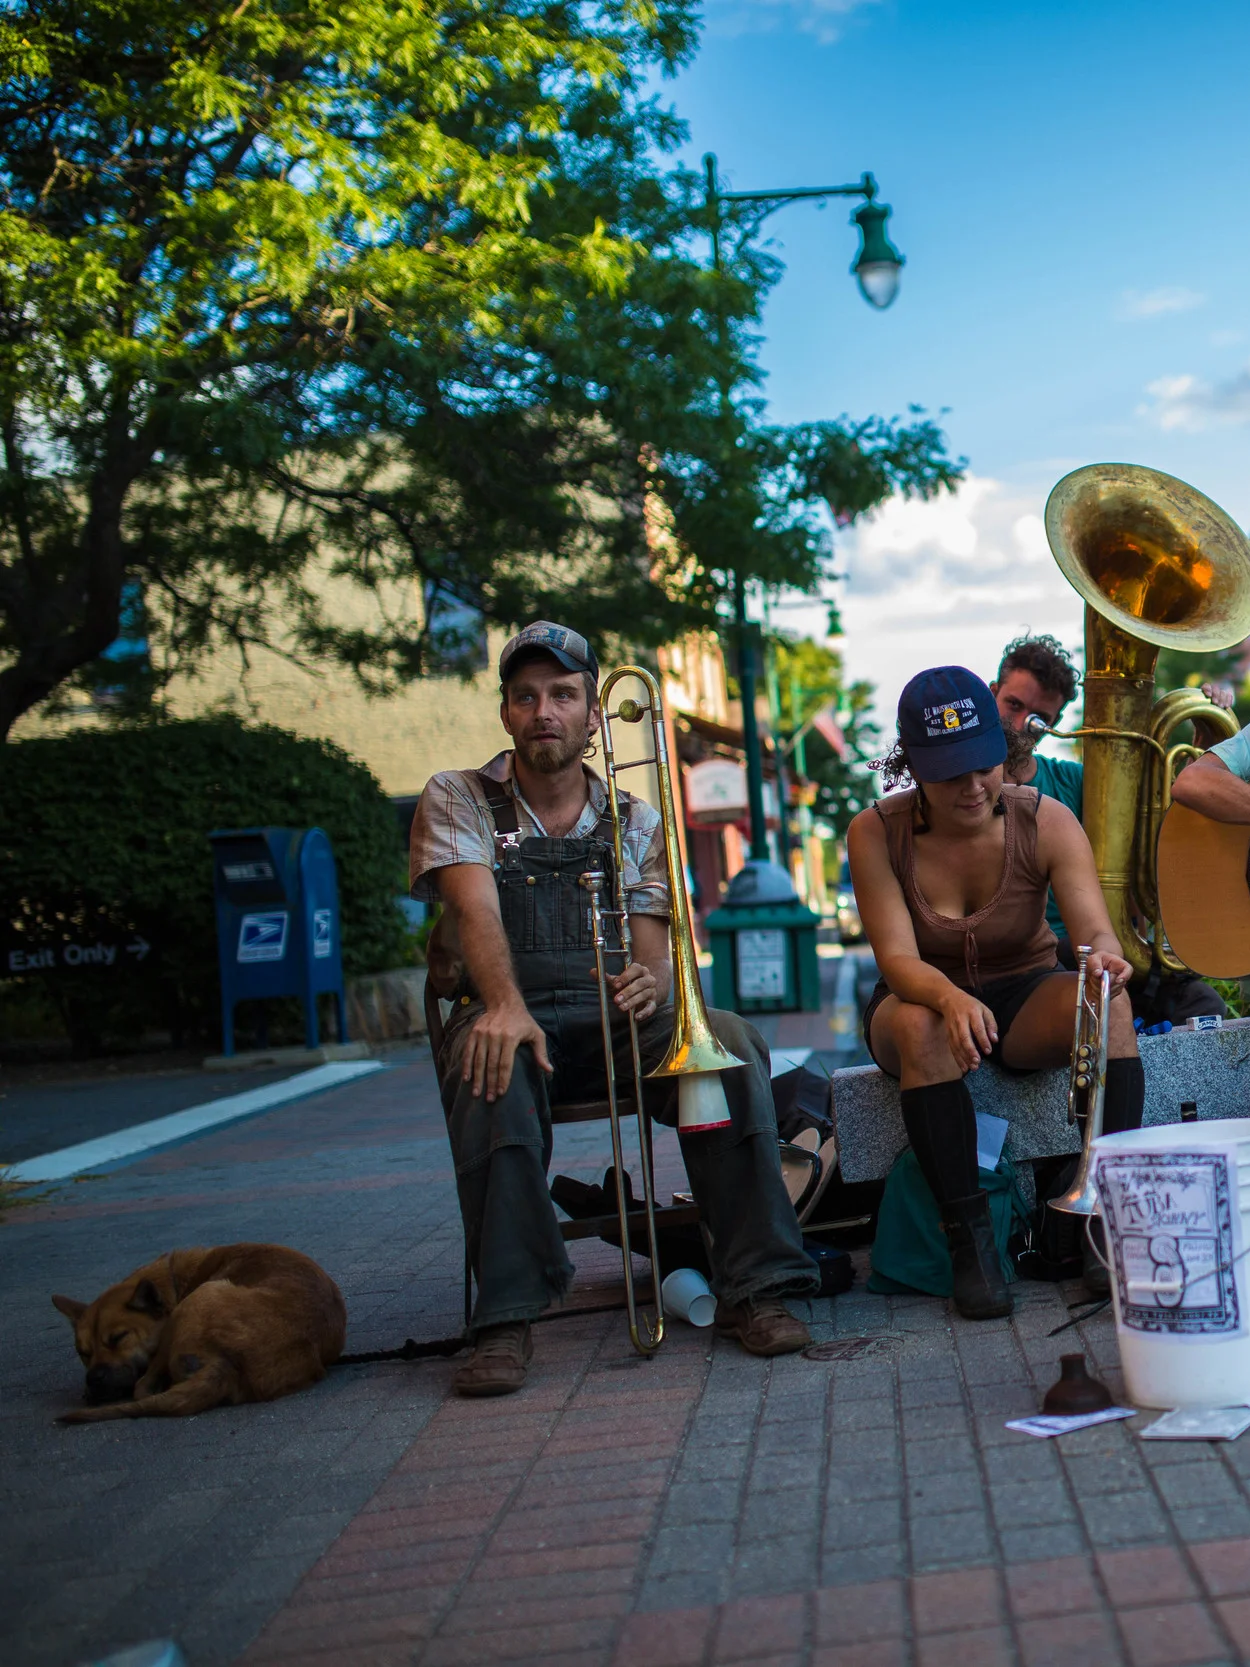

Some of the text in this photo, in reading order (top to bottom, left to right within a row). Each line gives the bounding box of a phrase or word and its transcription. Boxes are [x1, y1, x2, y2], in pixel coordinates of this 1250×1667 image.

[8, 941, 118, 971] Exit Only
[1197, 1021, 1219, 1029] CAMEL
